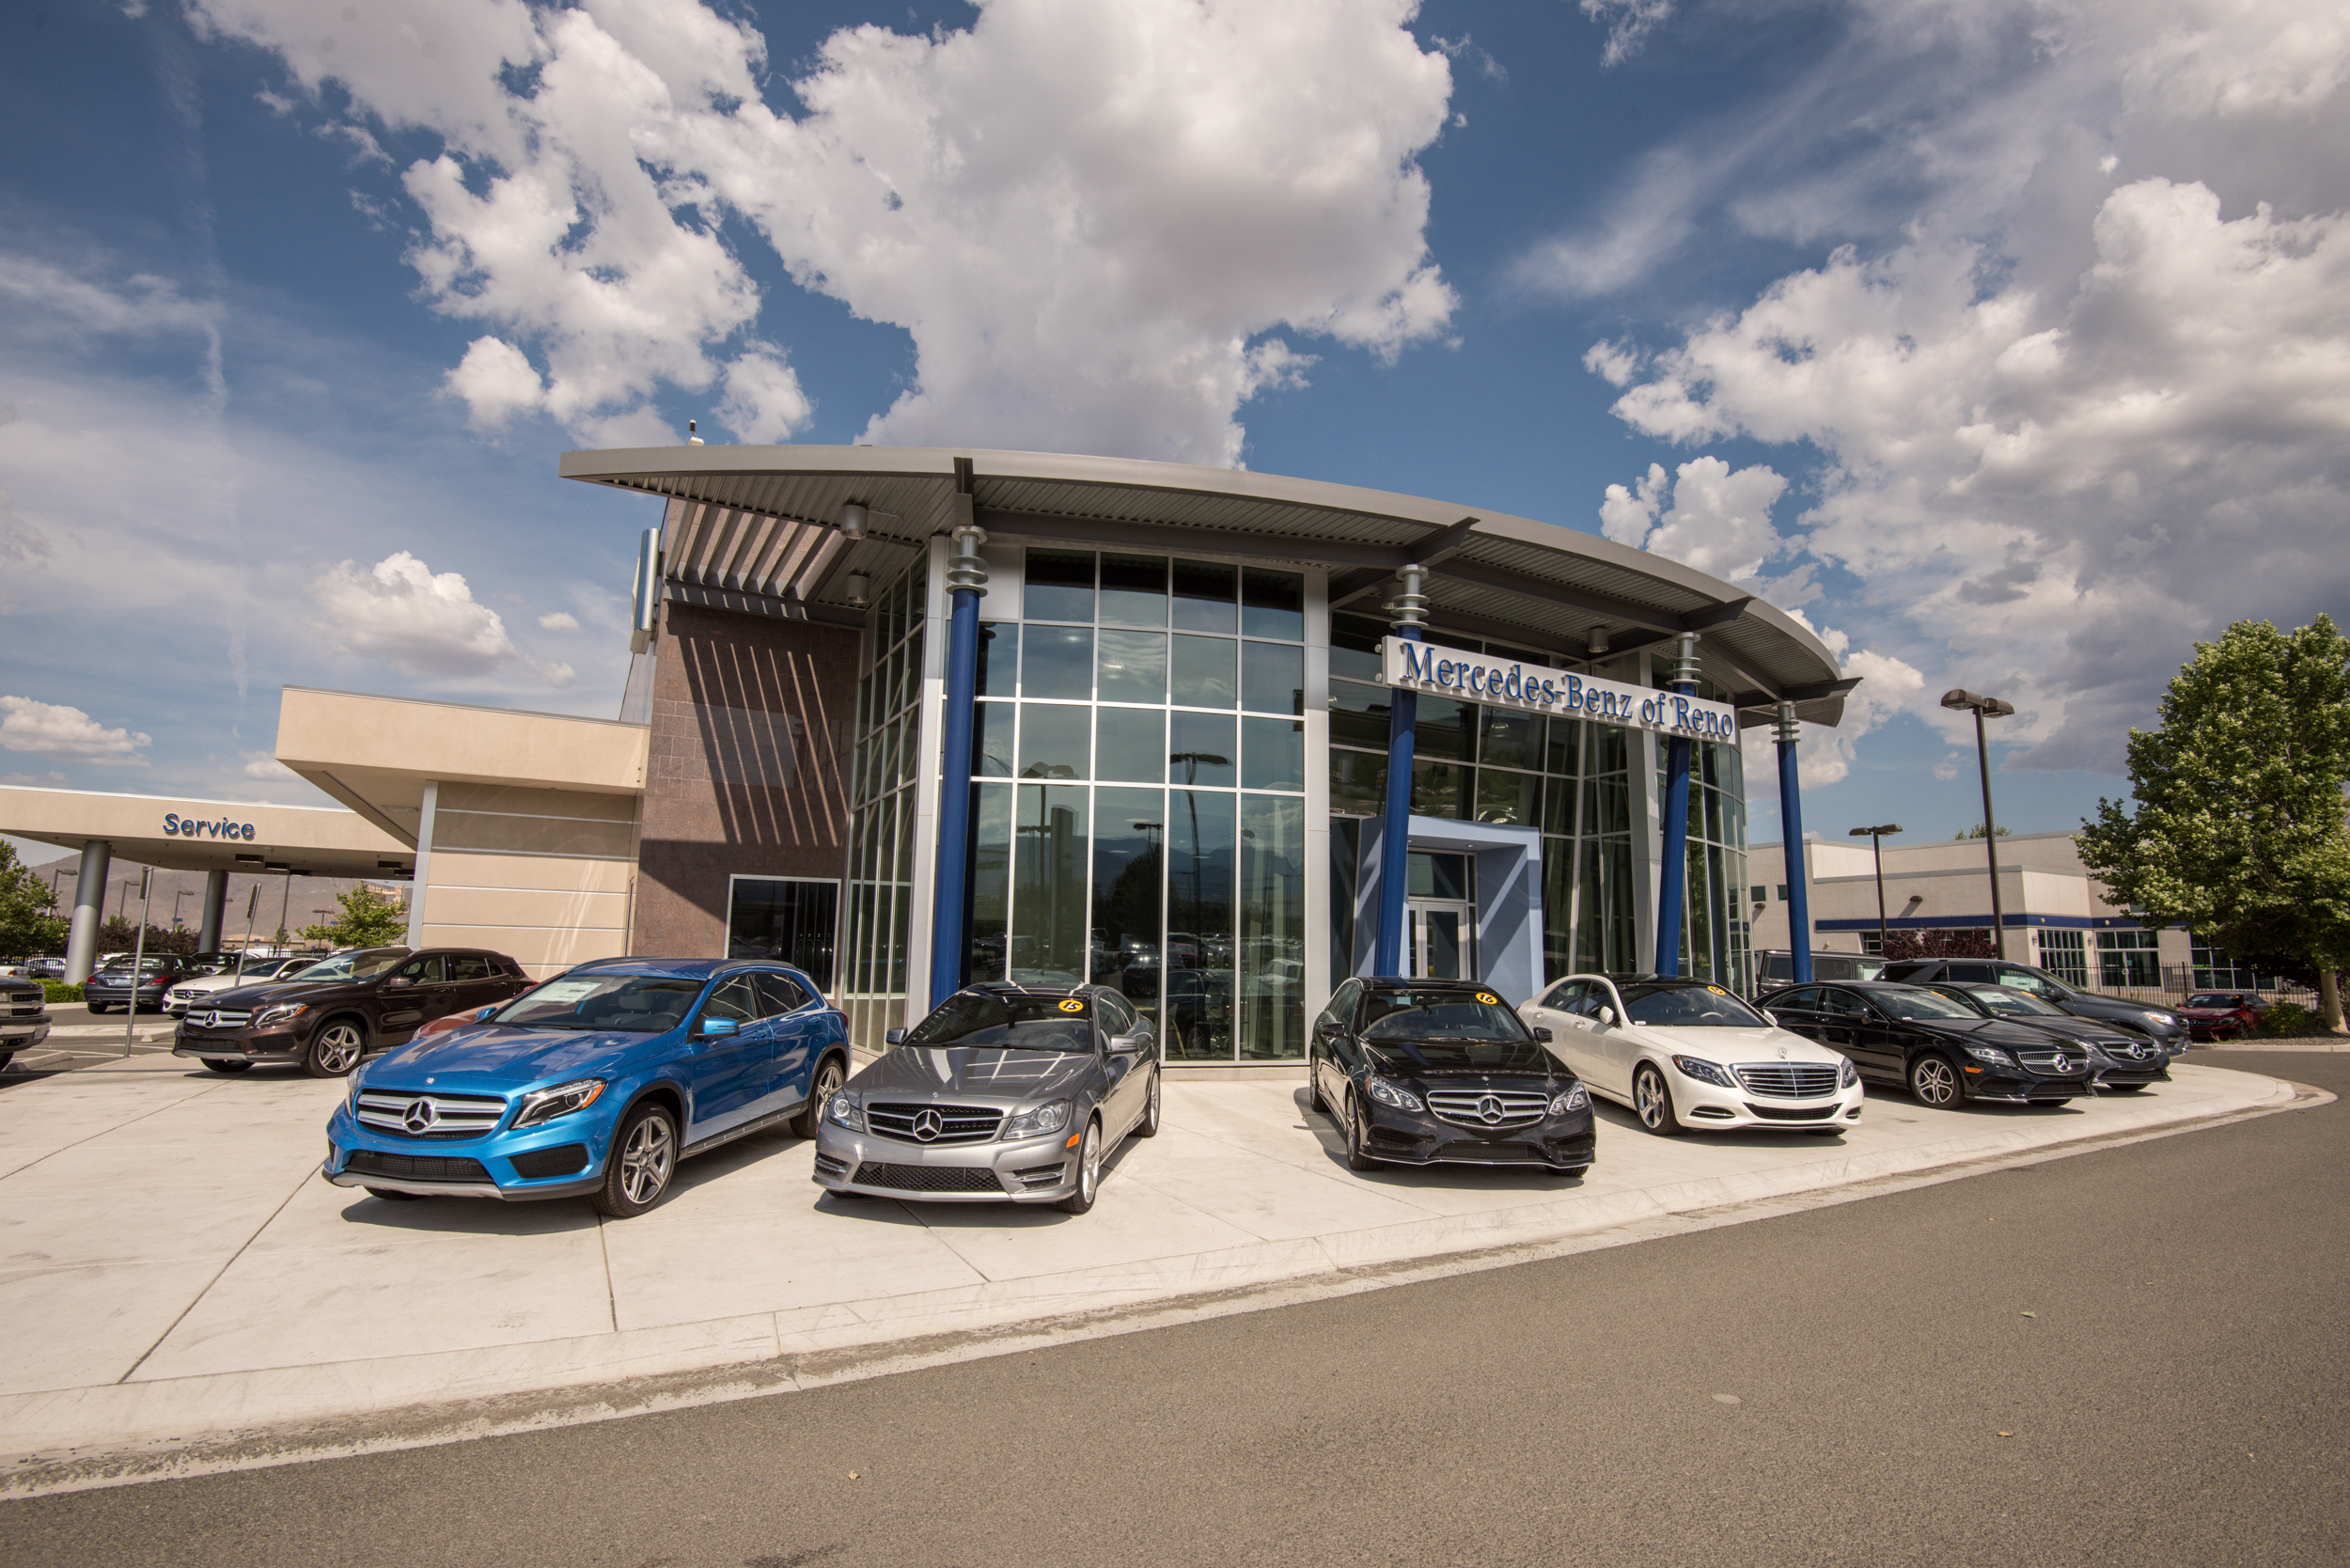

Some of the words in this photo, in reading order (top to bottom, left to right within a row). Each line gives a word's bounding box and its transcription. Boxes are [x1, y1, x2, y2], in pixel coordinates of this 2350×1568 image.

[1402, 642, 1633, 720] Mercedes-Benz
[1642, 693, 1666, 725] of
[1673, 696, 1733, 738] Reno
[163, 813, 255, 839] Service
